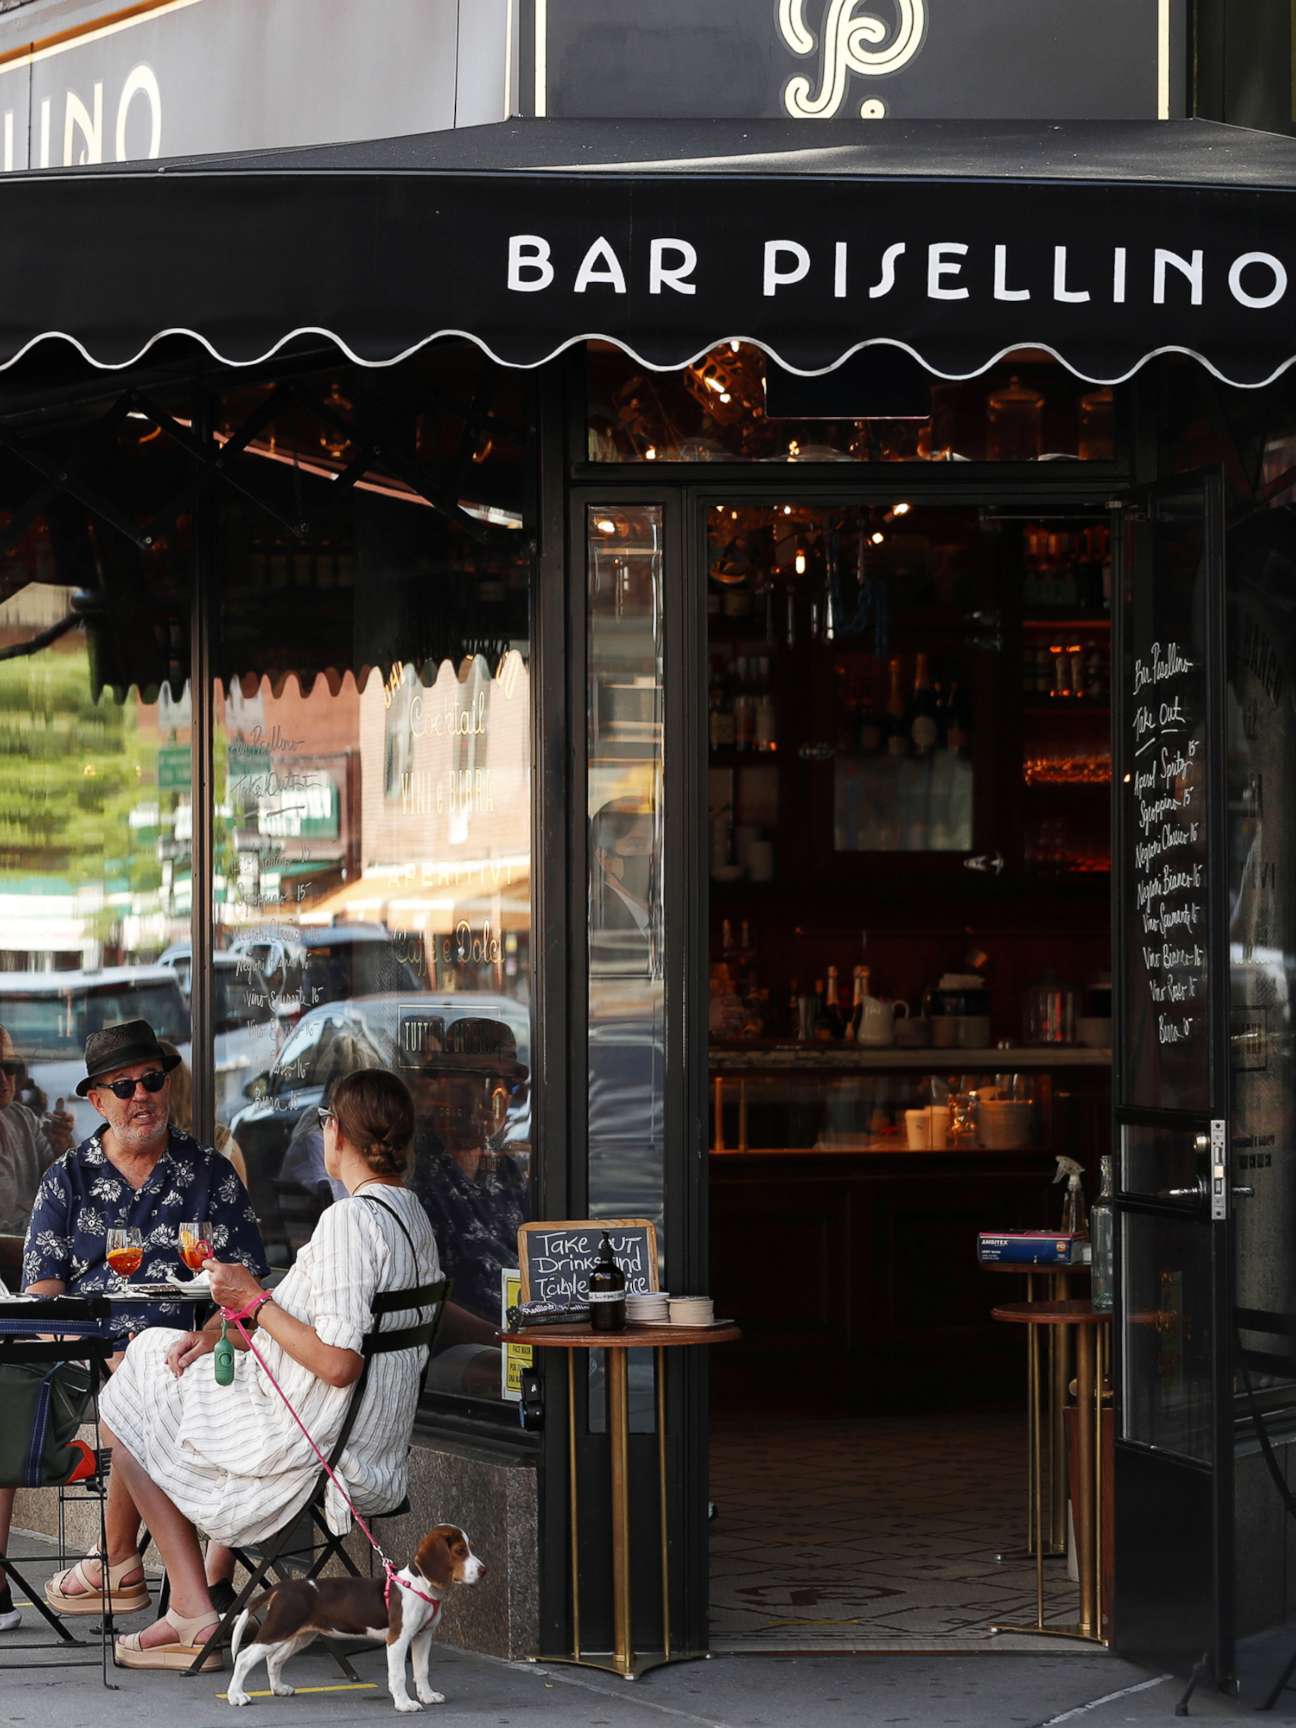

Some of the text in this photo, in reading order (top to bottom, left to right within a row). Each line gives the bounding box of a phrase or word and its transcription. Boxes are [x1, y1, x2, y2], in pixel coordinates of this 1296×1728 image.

[507, 234, 1288, 310] BAR PISELLINO
[1132, 695, 1186, 741] Take Out
[535, 1232, 592, 1257] Take
[531, 1254, 601, 1274] Drinks
